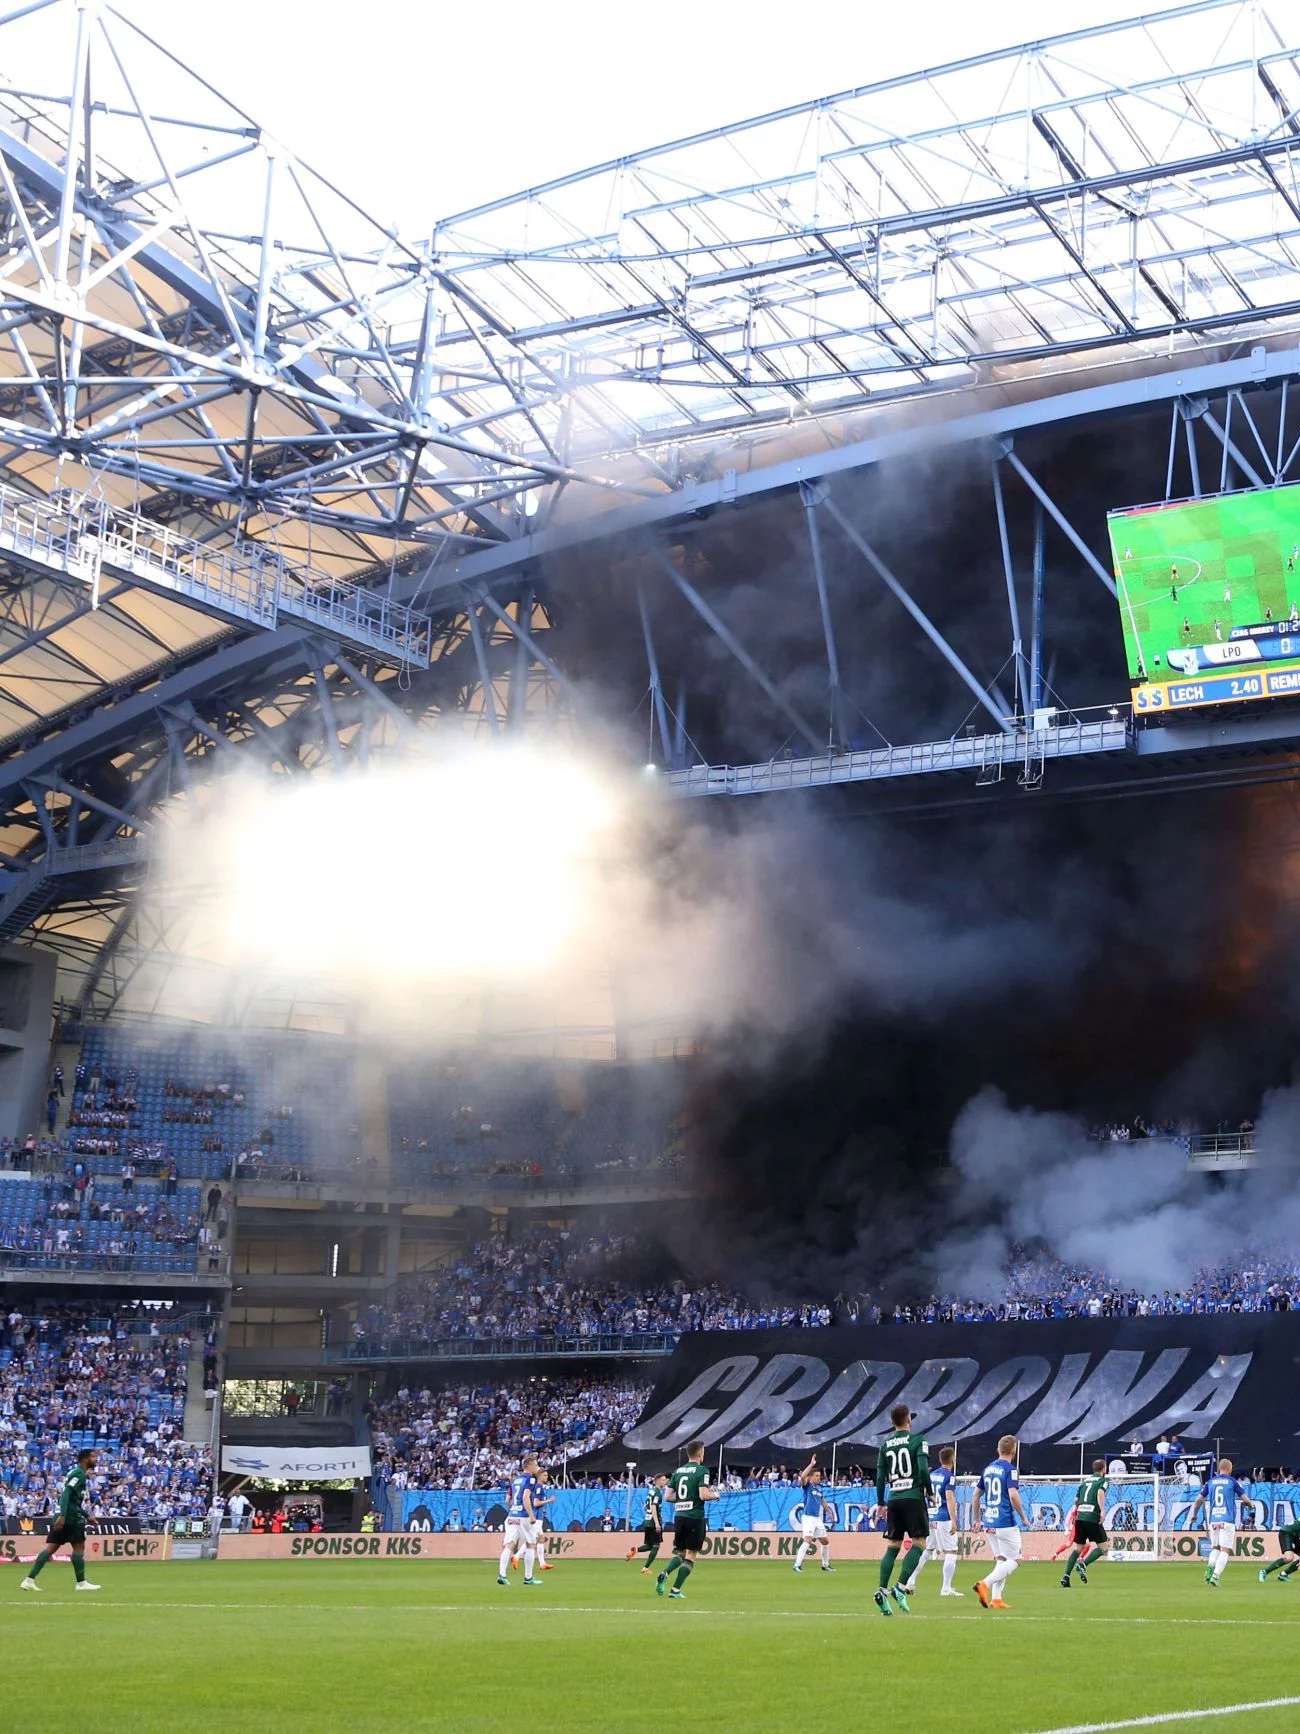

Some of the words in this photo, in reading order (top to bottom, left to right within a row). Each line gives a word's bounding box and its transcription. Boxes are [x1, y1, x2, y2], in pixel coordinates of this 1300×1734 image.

[1223, 646, 1241, 658] LPO
[1171, 686, 1204, 703] LECH
[1230, 679, 1259, 695] 2.40
[280, 1461, 356, 1472] AFORTI
[885, 1447, 913, 1480] 20
[514, 1485, 521, 1506] 7
[678, 1475, 689, 1500] 6
[1084, 1482, 1093, 1503] 7
[1214, 1485, 1224, 1507] 6
[103, 1538, 148, 1557] LECH
[291, 1537, 380, 1555] SPONSOR
[386, 1537, 422, 1555] KKS
[674, 1536, 771, 1556] ONSOR
[1109, 1536, 1206, 1556] PONSO
[1230, 1536, 1265, 1557] KS
